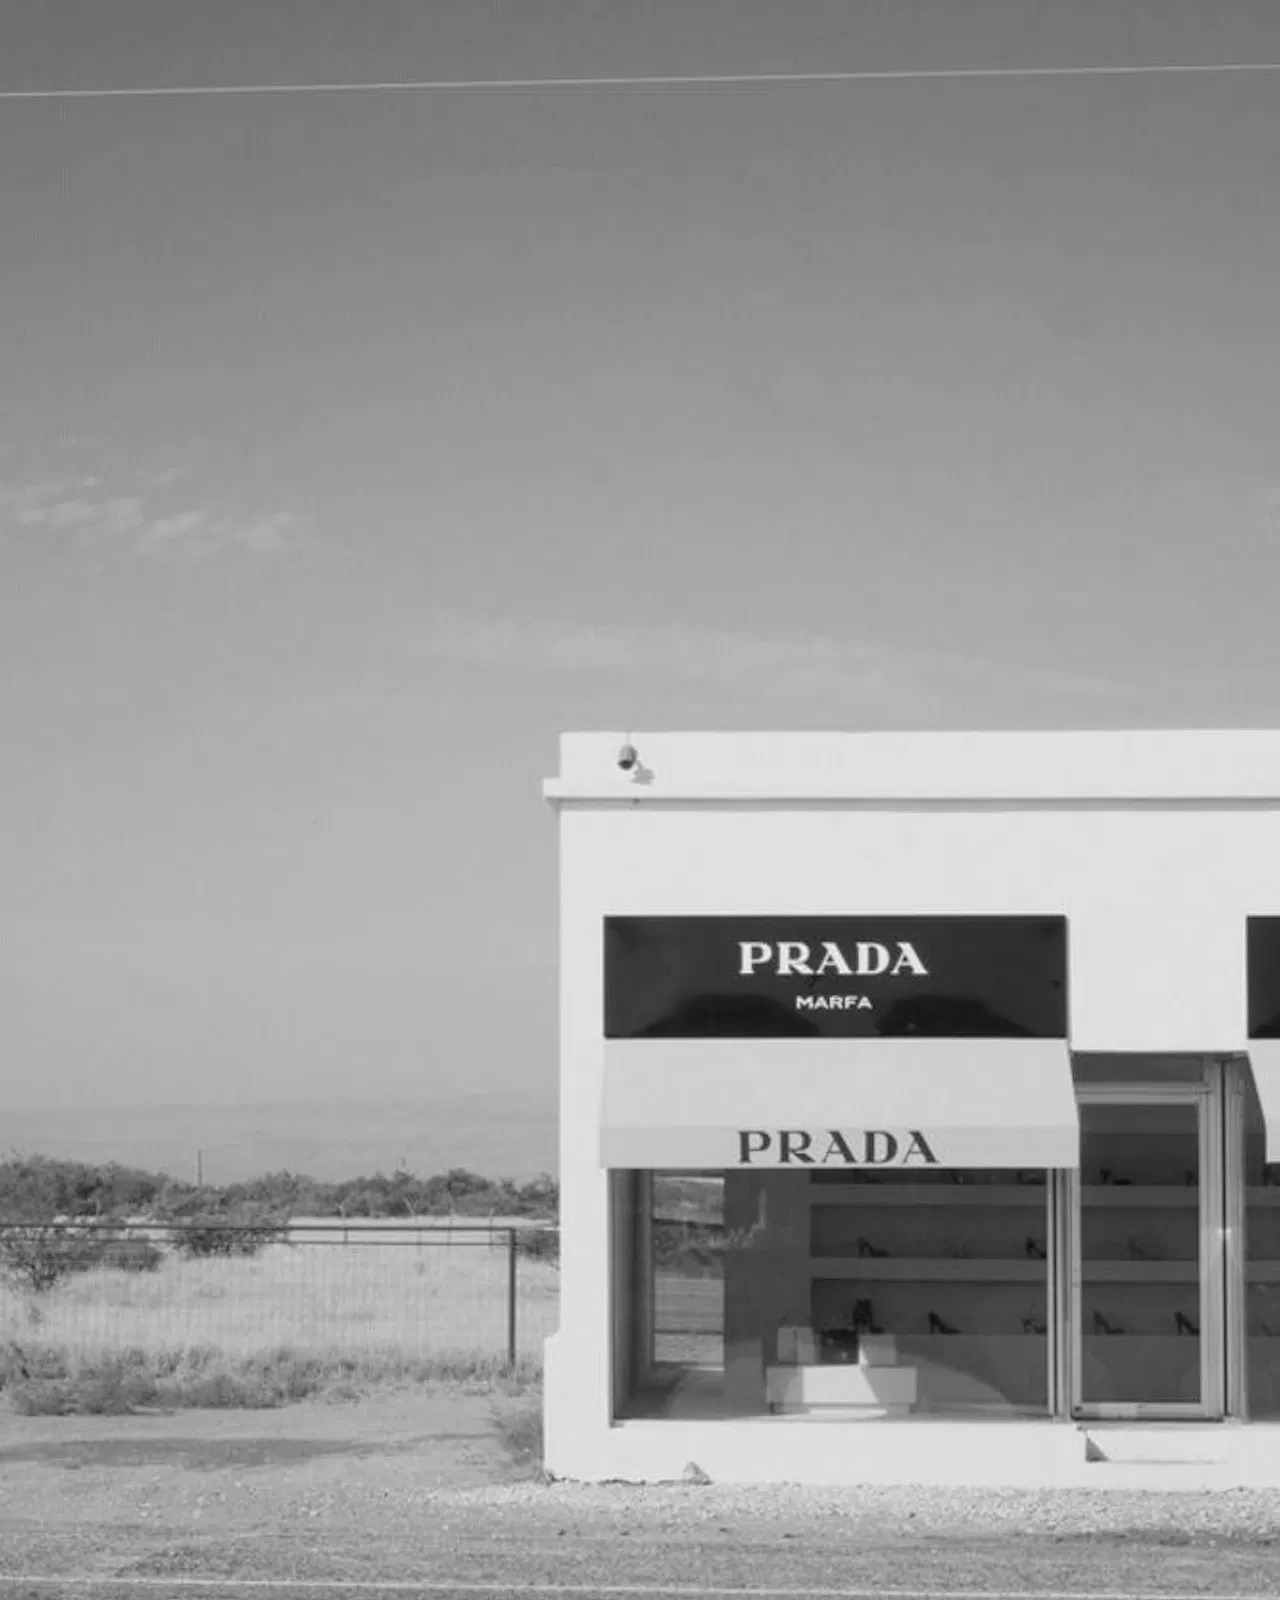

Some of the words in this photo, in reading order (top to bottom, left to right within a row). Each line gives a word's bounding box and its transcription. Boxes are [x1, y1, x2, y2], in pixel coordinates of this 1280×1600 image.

[738, 941, 929, 976] PRADA
[795, 994, 872, 1010] MARFA
[738, 1130, 939, 1164] PRADA
